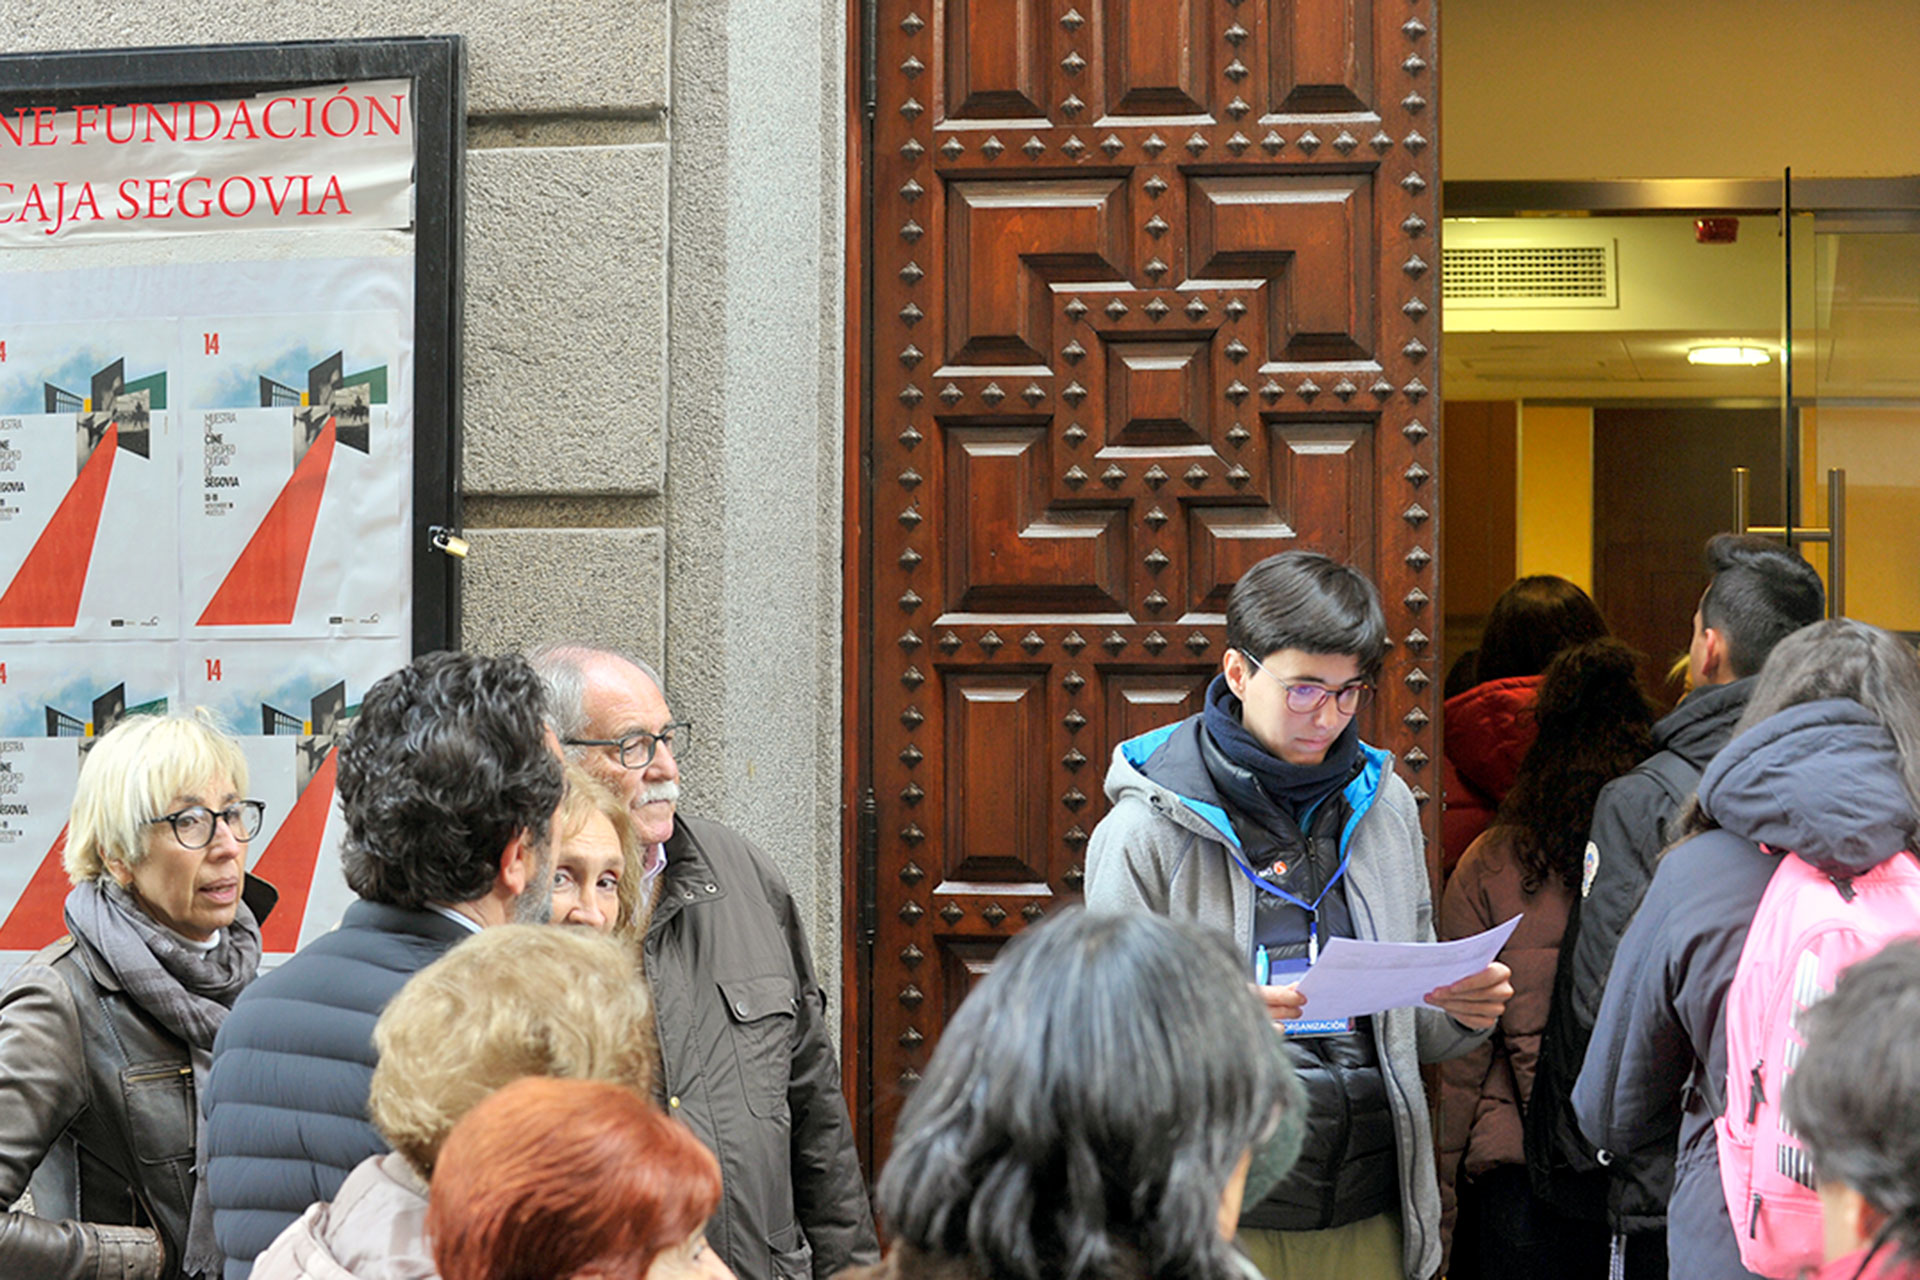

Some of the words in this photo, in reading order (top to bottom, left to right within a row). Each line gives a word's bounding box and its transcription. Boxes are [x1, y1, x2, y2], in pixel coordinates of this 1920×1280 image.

[0, 106, 59, 147] NE
[71, 86, 406, 145] FUNDACIÓN
[117, 175, 352, 221] SEGOVIA
[203, 332, 220, 355] 14
[204, 412, 237, 423] MUESTRA
[204, 433, 223, 444] CINE
[204, 477, 239, 488] SEGOVIA
[205, 659, 222, 681] 14
[1284, 1020, 1346, 1031] ORGANIZACIÓN
